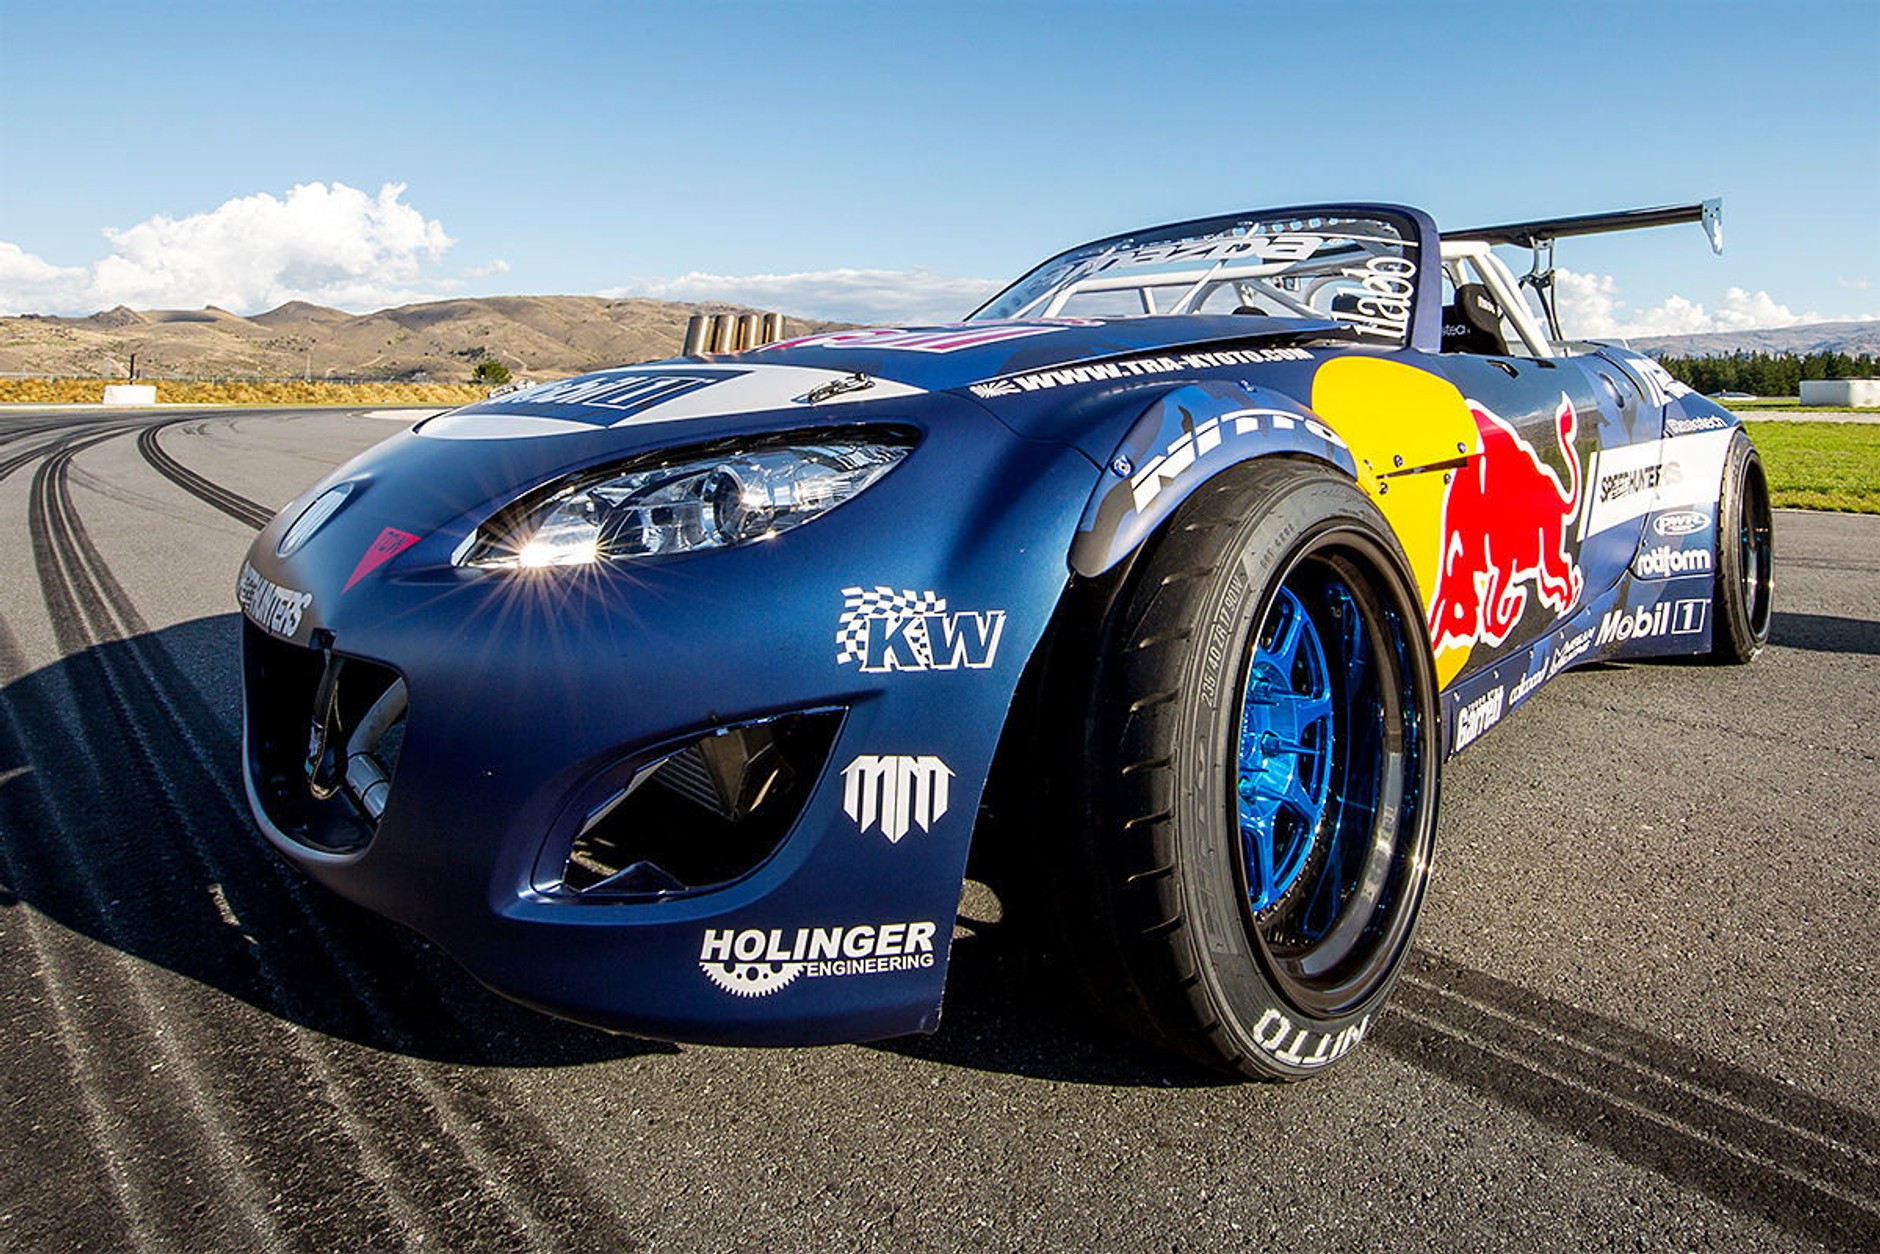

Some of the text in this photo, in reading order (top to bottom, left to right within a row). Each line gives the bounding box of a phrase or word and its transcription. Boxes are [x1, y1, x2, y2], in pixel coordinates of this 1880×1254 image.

[1013, 348, 1315, 391] WWW.TRA-KYOTO.COM
[1638, 545, 1711, 577] rotiform
[859, 609, 1006, 672] KW
[1595, 602, 1671, 646] Mobil
[1456, 692, 1504, 751] Garrett
[700, 921, 936, 961] HOLINGER
[807, 953, 934, 978] ENGINEERING
[1253, 1008, 1371, 1065] NITTO
